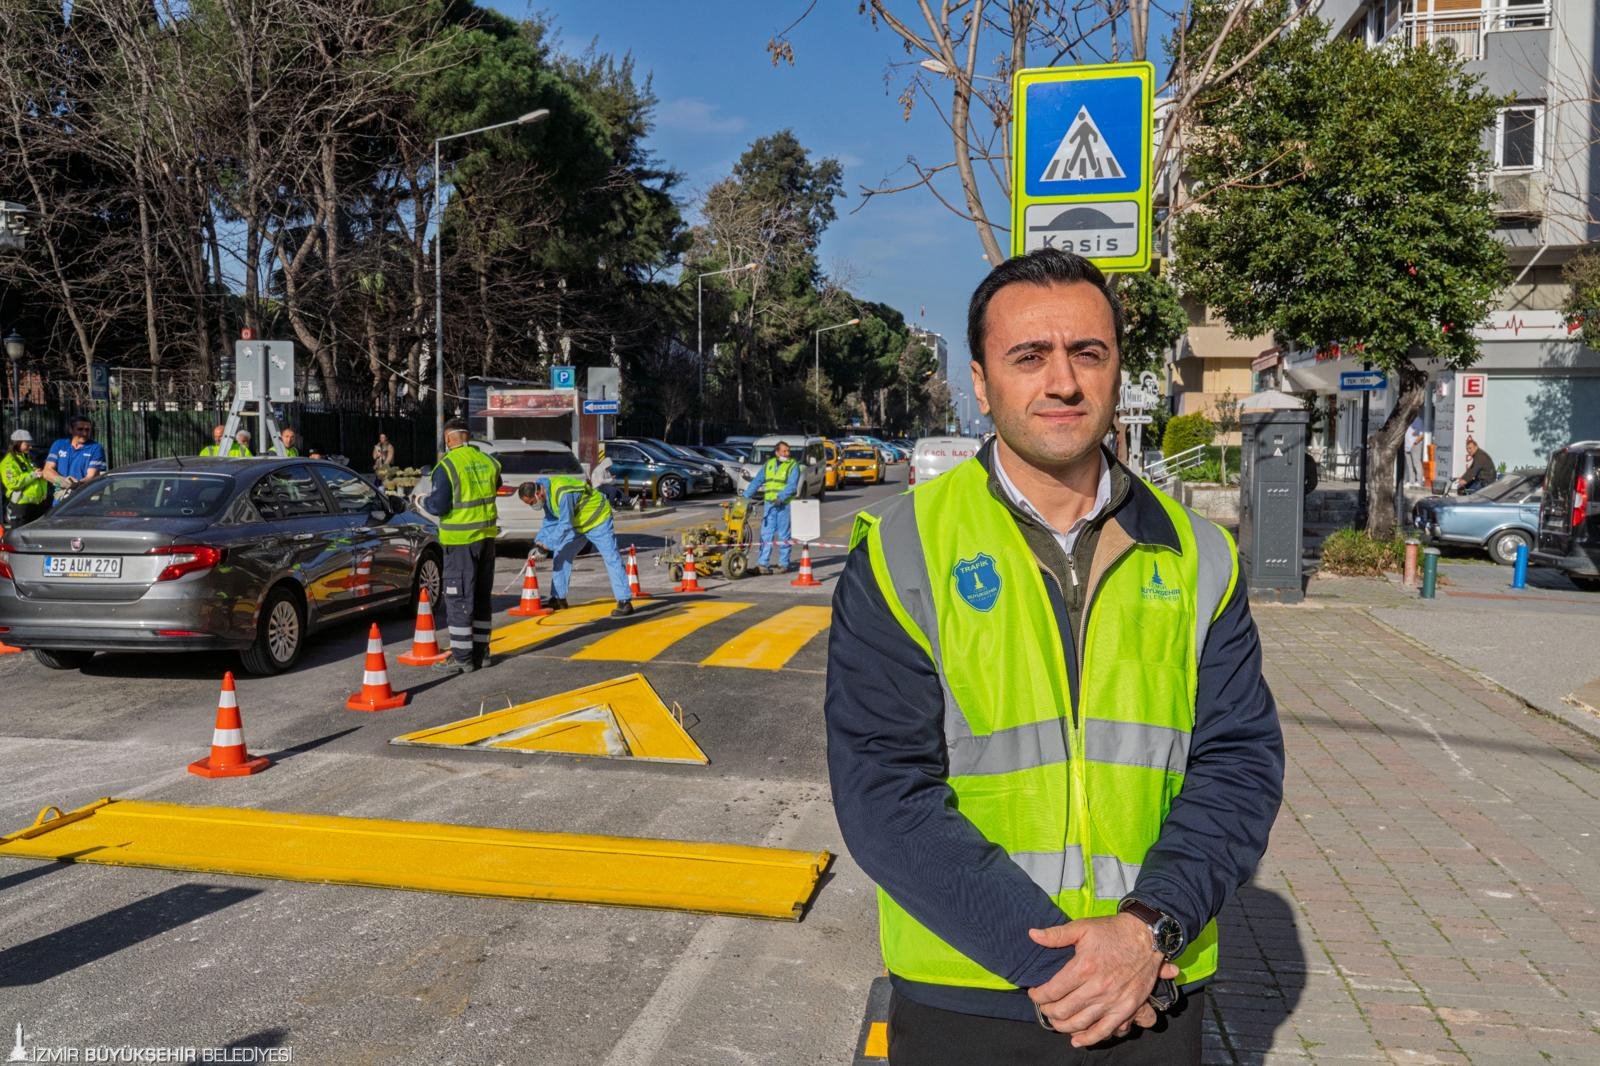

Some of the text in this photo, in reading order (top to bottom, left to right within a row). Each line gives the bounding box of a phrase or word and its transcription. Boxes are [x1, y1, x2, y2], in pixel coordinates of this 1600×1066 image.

[1042, 235, 1119, 252] Kasis
[560, 371, 569, 382] P
[1359, 376, 1371, 384] YÖN
[1467, 378, 1480, 393] E
[52, 558, 119, 573] 35 AUM 270
